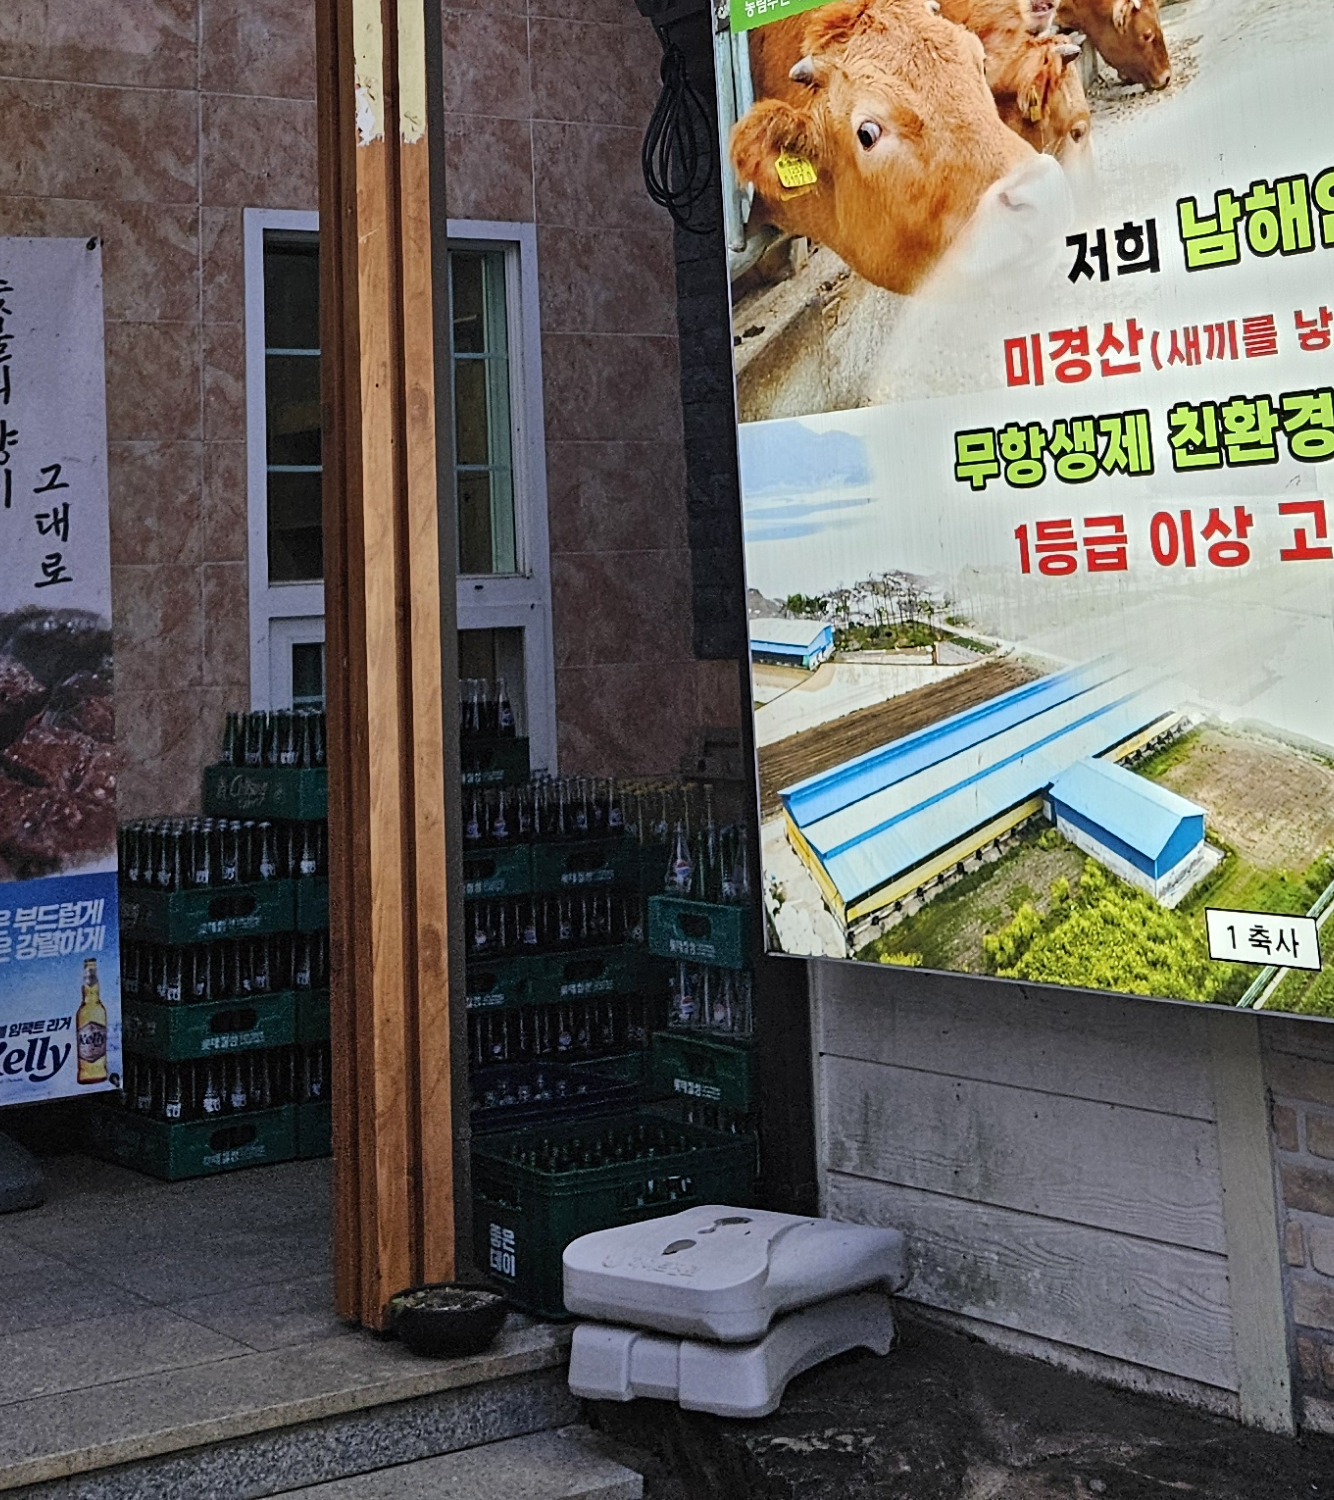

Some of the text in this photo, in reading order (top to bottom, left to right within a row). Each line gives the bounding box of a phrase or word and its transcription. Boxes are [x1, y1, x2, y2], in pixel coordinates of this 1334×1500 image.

[1064, 217, 1161, 285] 저희
[953, 409, 1154, 490] 무항생제
[32, 463, 74, 590] 그대로
[1013, 513, 1129, 577] 1등급
[1148, 505, 1255, 569] 이상
[13, 898, 105, 931] 부드럽게
[15, 924, 106, 962] 강렬하게
[1226, 924, 1300, 959] 1 축사
[9, 1020, 46, 1039] 임팩트
